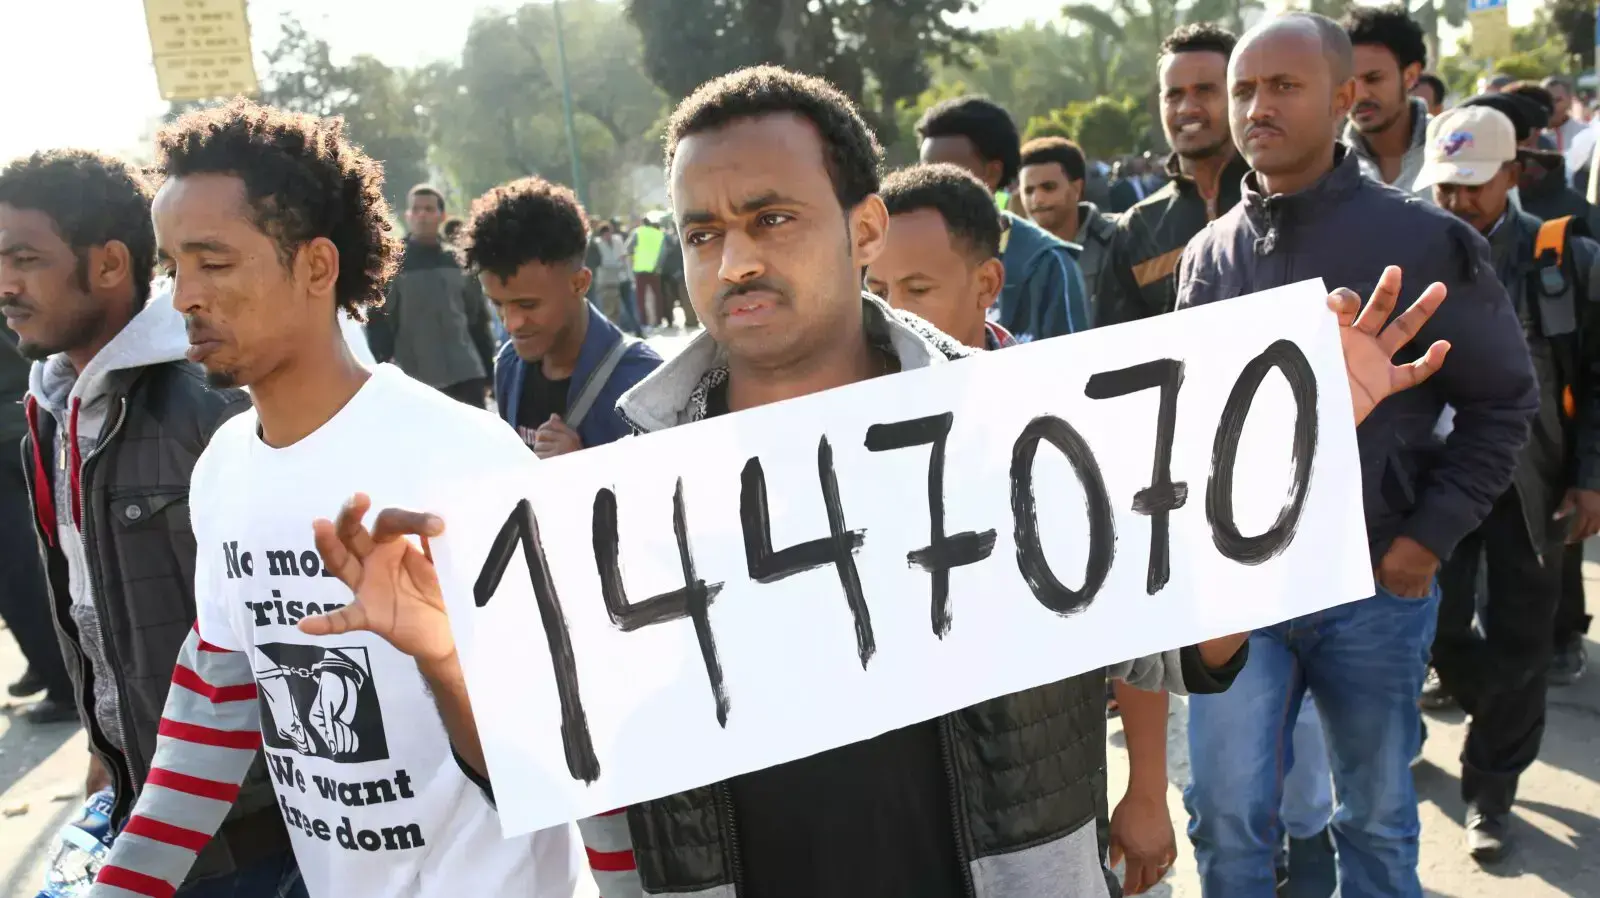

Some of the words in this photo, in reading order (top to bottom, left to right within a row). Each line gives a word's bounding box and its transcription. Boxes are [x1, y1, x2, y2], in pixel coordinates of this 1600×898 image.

[223, 541, 254, 579] No
[266, 550, 337, 577] mo
[474, 339, 1320, 785] 1447070
[265, 751, 306, 793] We
[312, 769, 414, 806] want
